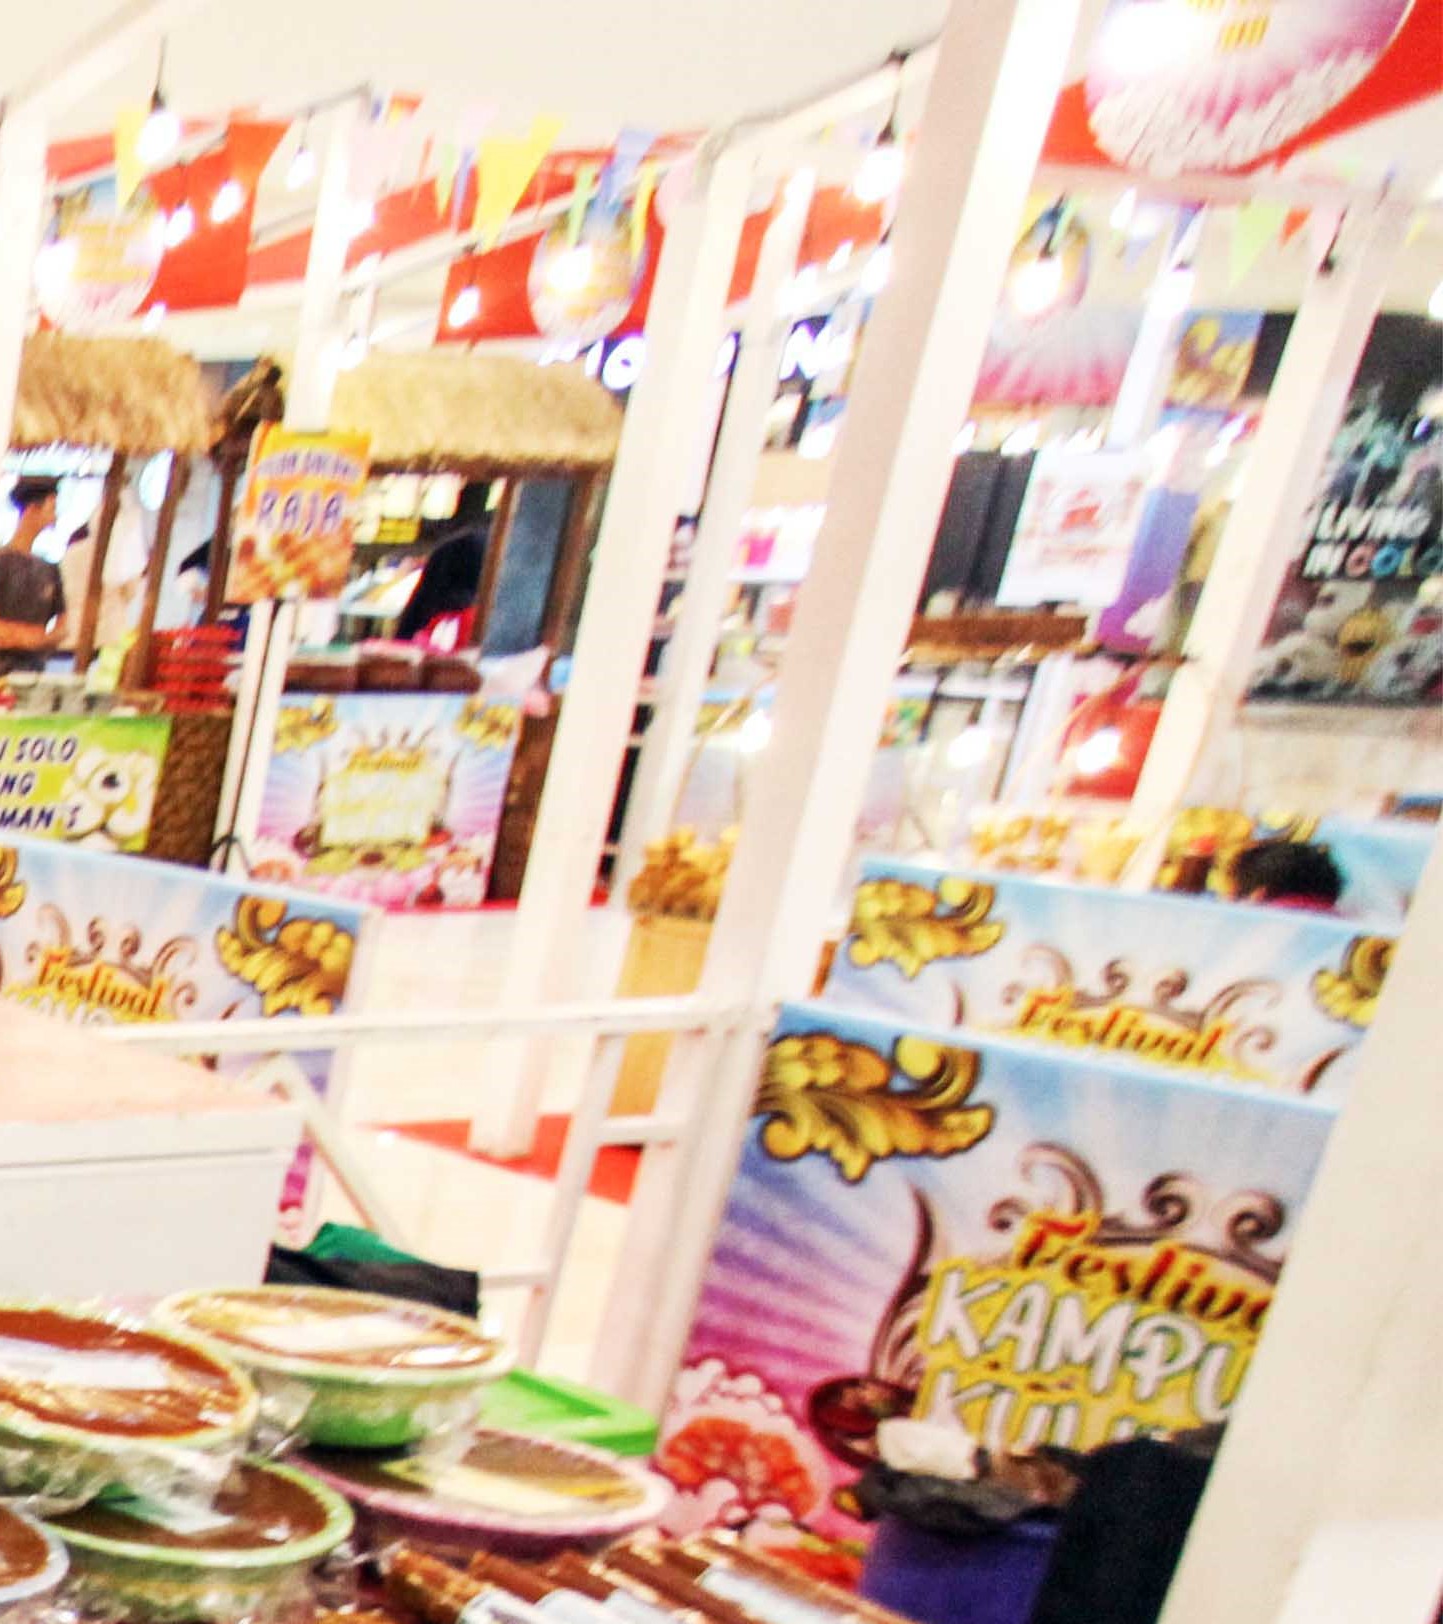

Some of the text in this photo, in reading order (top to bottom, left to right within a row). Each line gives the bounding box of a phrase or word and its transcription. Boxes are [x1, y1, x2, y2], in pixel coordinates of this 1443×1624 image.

[14, 735, 77, 763] SOLO
[36, 951, 167, 1018] Festival
[1019, 993, 1224, 1064] Festival
